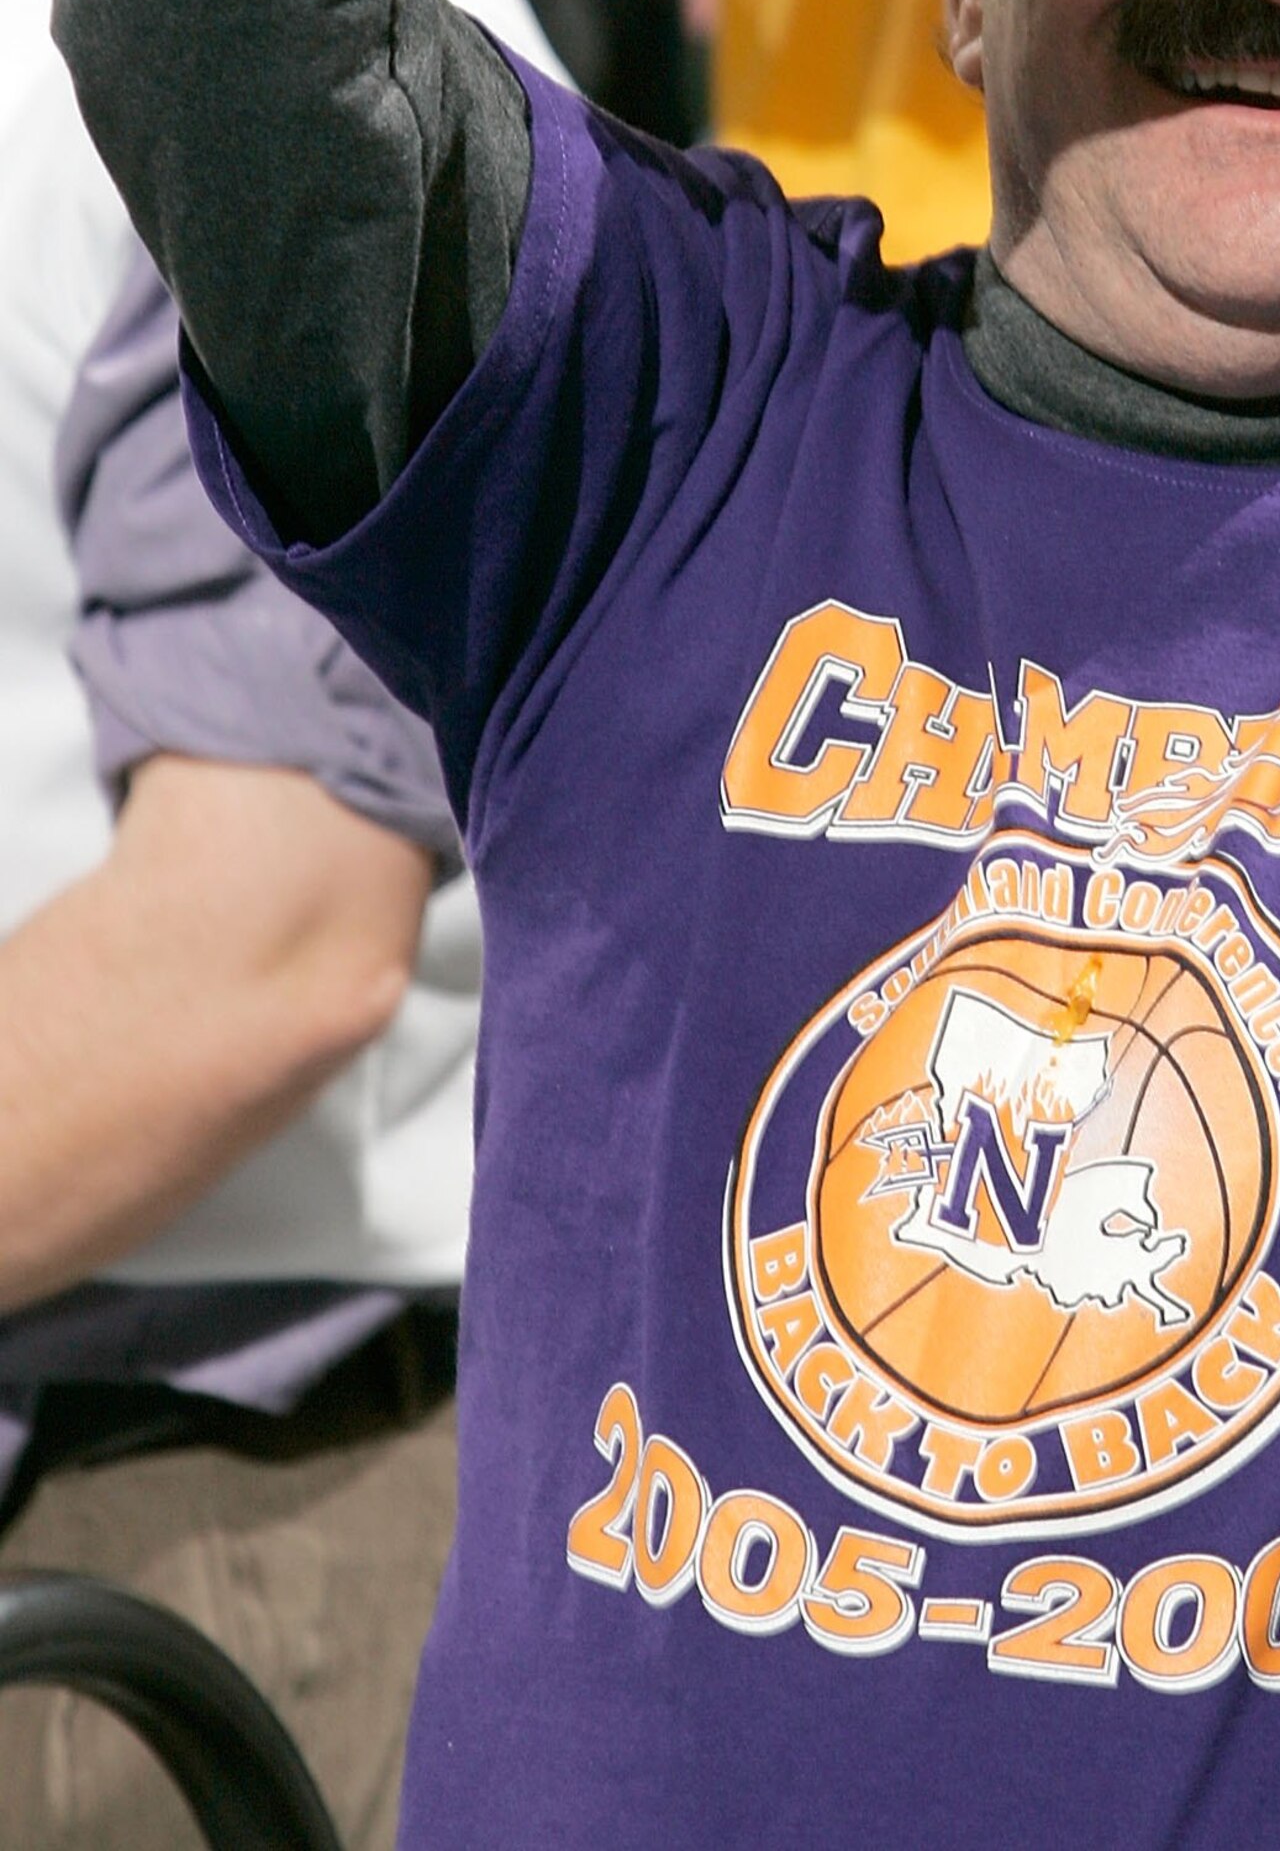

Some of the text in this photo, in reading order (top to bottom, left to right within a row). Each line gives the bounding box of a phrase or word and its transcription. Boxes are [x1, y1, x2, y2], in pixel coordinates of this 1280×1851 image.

[929, 1088, 1074, 1255] N
[749, 1221, 920, 1475] BACK
[919, 1421, 1038, 1503] TO
